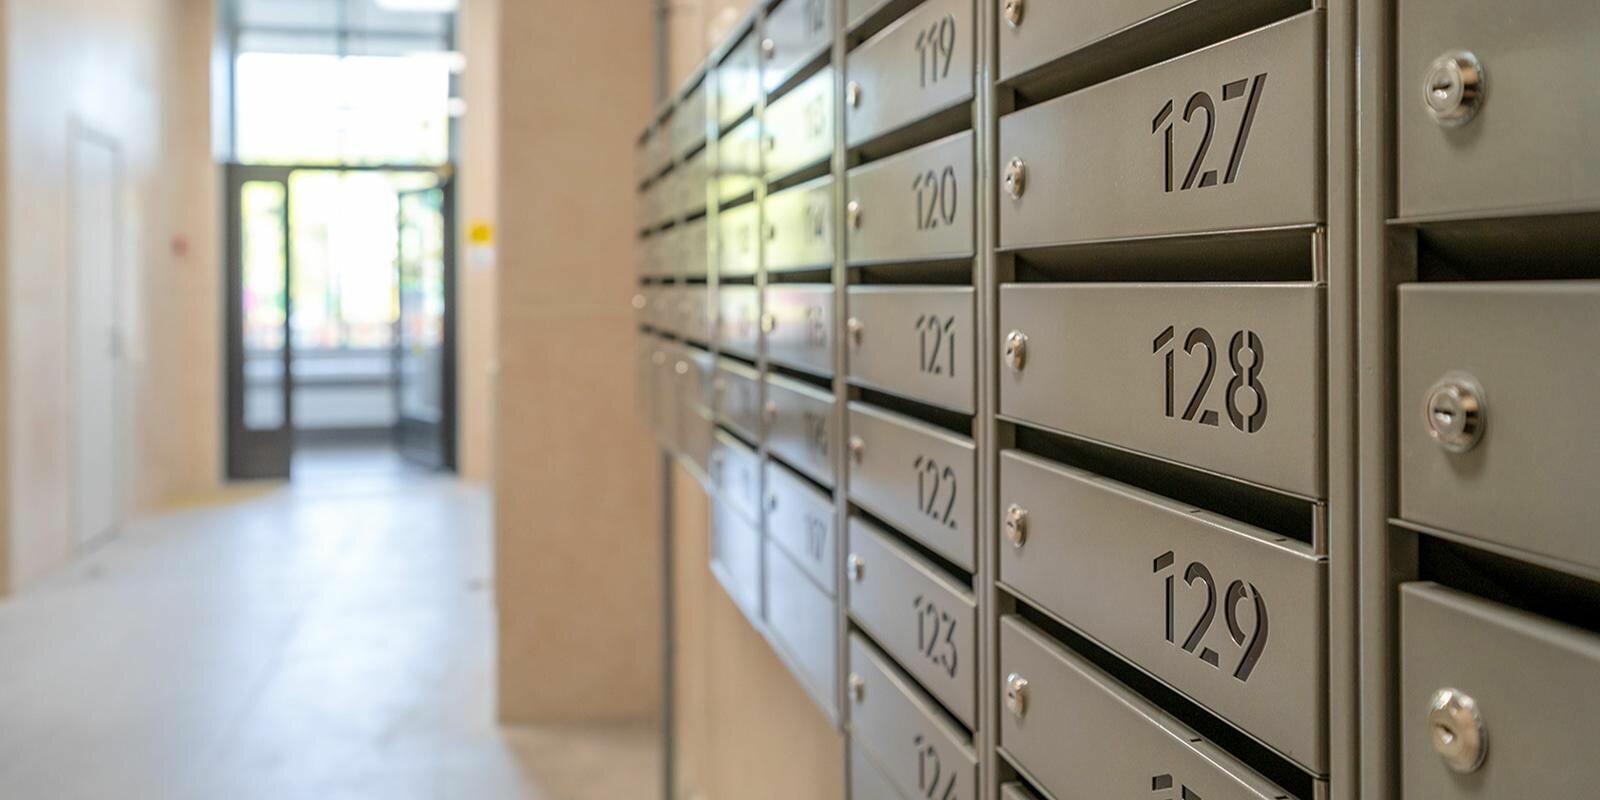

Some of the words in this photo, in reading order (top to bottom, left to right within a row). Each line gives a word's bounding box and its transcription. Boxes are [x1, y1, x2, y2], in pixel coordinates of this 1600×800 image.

[914, 14, 957, 87] 119
[1152, 72, 1267, 192] 127
[913, 166, 957, 230] 120
[916, 315, 954, 377] 121
[1153, 325, 1267, 433] 128
[914, 456, 956, 528] 122
[914, 596, 958, 678] 123
[1153, 550, 1268, 682] 129
